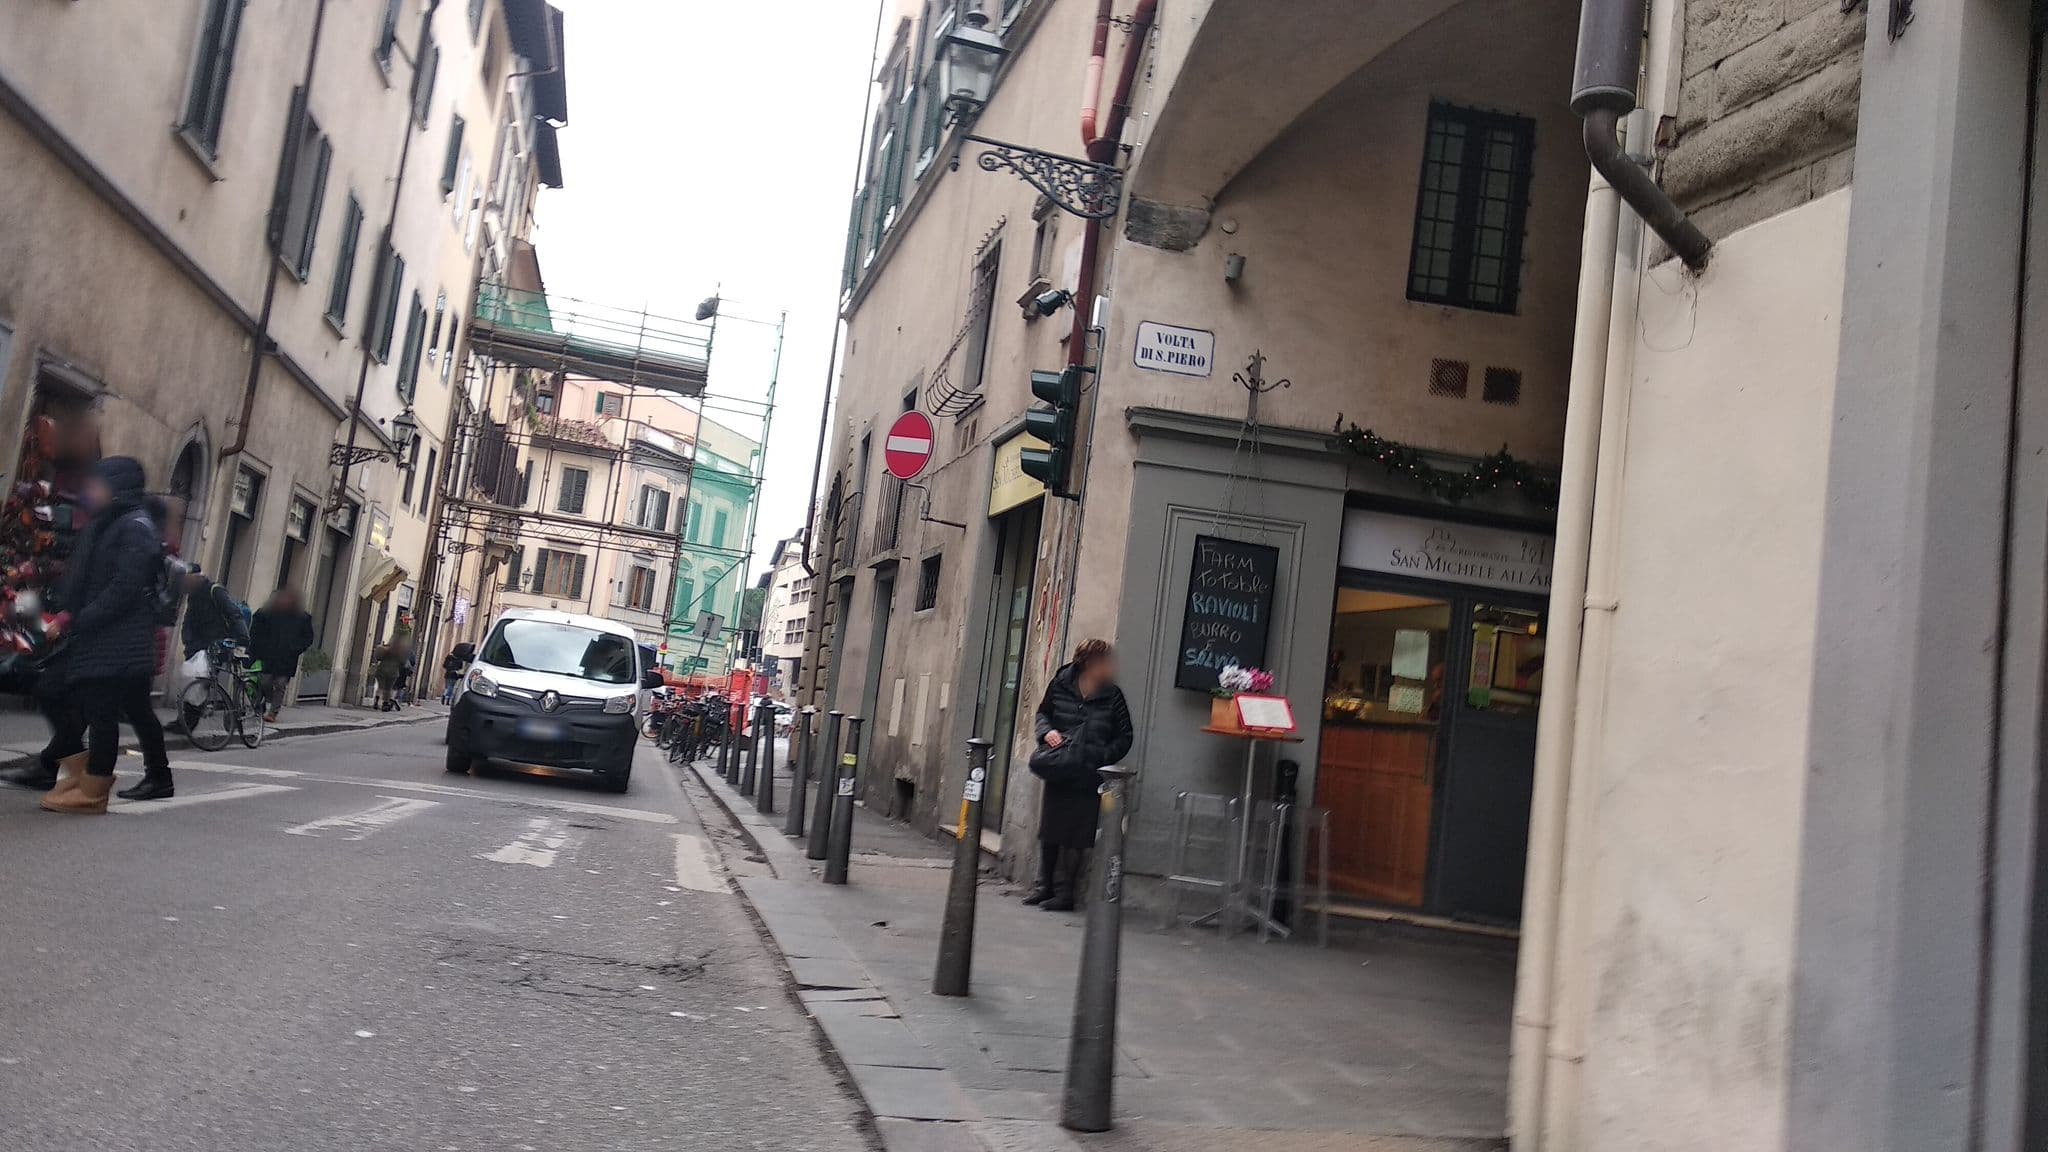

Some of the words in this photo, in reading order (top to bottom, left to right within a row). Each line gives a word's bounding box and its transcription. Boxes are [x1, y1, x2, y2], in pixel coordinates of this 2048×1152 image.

[1157, 332, 1195, 349] VOLTA
[1141, 347, 1153, 360] DI
[1201, 544, 1253, 572] FARM
[1191, 622, 1241, 644] BURRO
